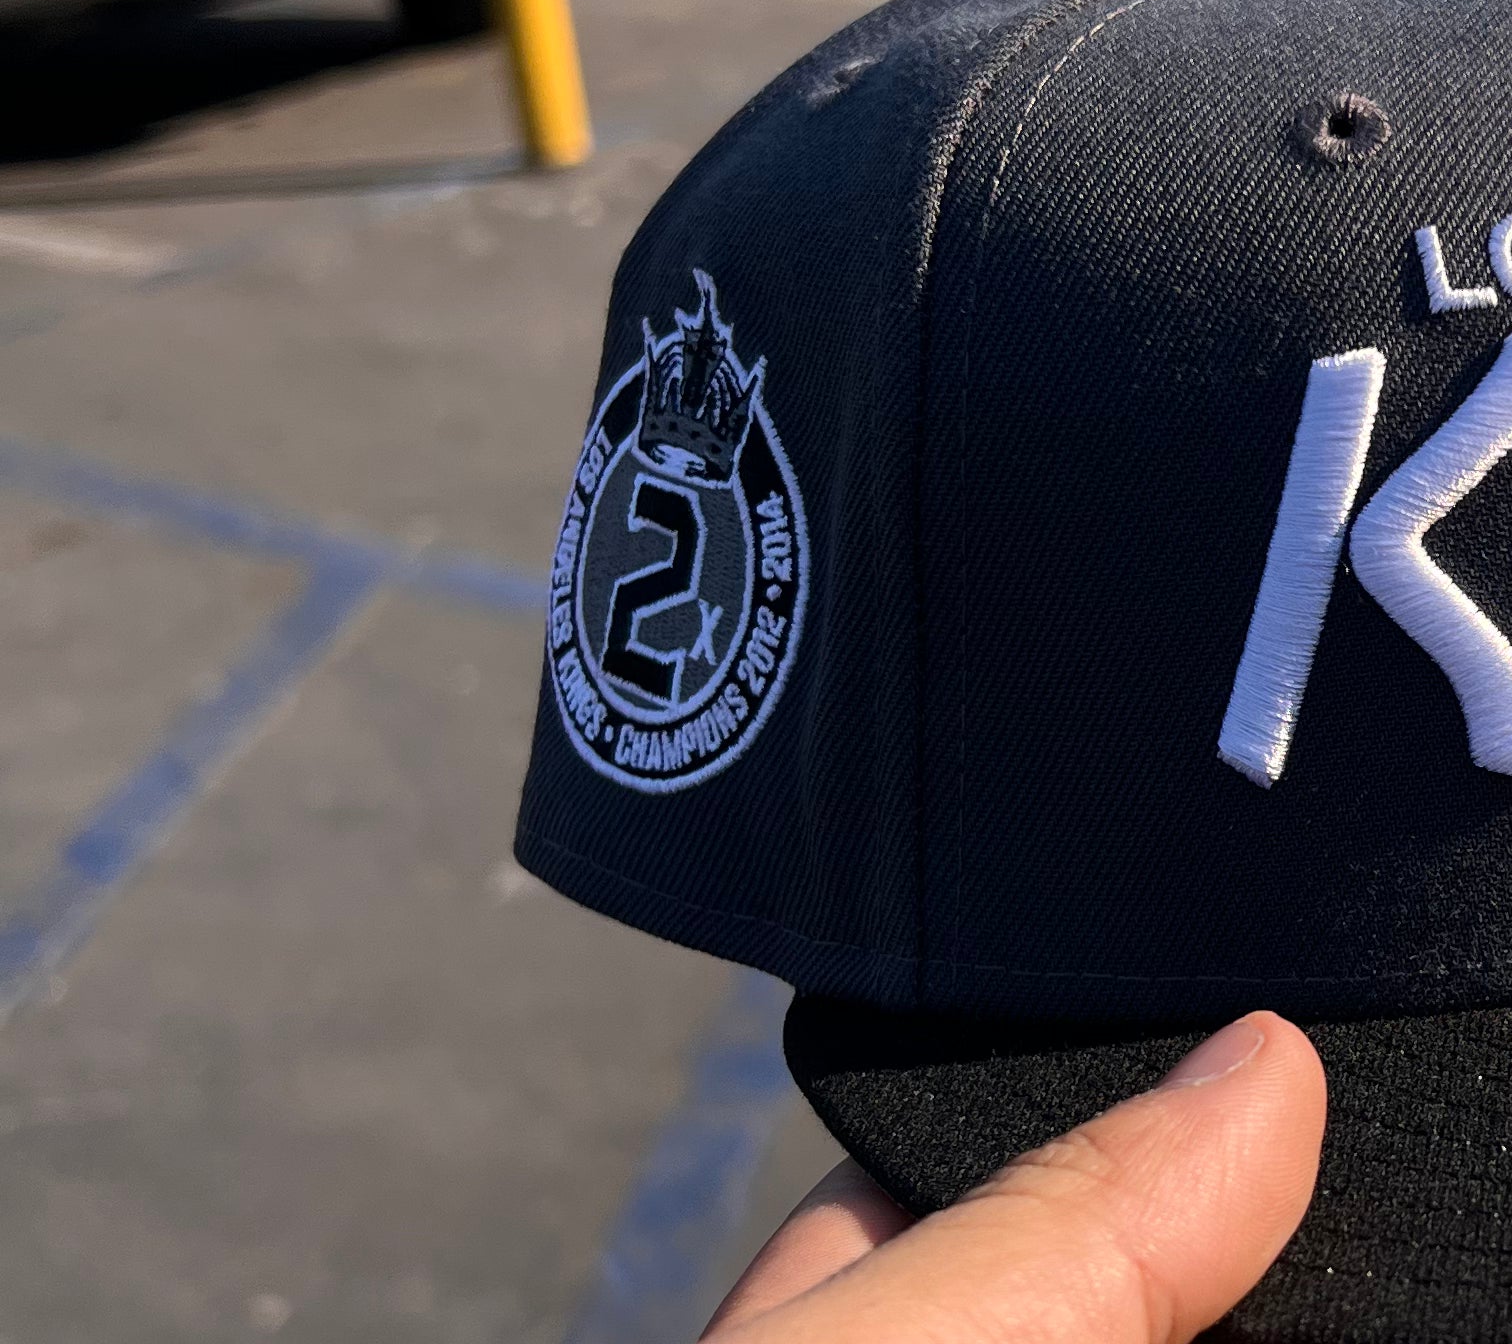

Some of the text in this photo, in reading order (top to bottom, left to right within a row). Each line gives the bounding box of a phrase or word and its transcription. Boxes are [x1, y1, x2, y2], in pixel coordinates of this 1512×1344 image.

[552, 492, 585, 649] ANGELES
[757, 490, 792, 581] 2014
[558, 648, 606, 741] KINGS
[738, 606, 787, 696] 2012
[615, 684, 748, 771] CHAMPIONS
